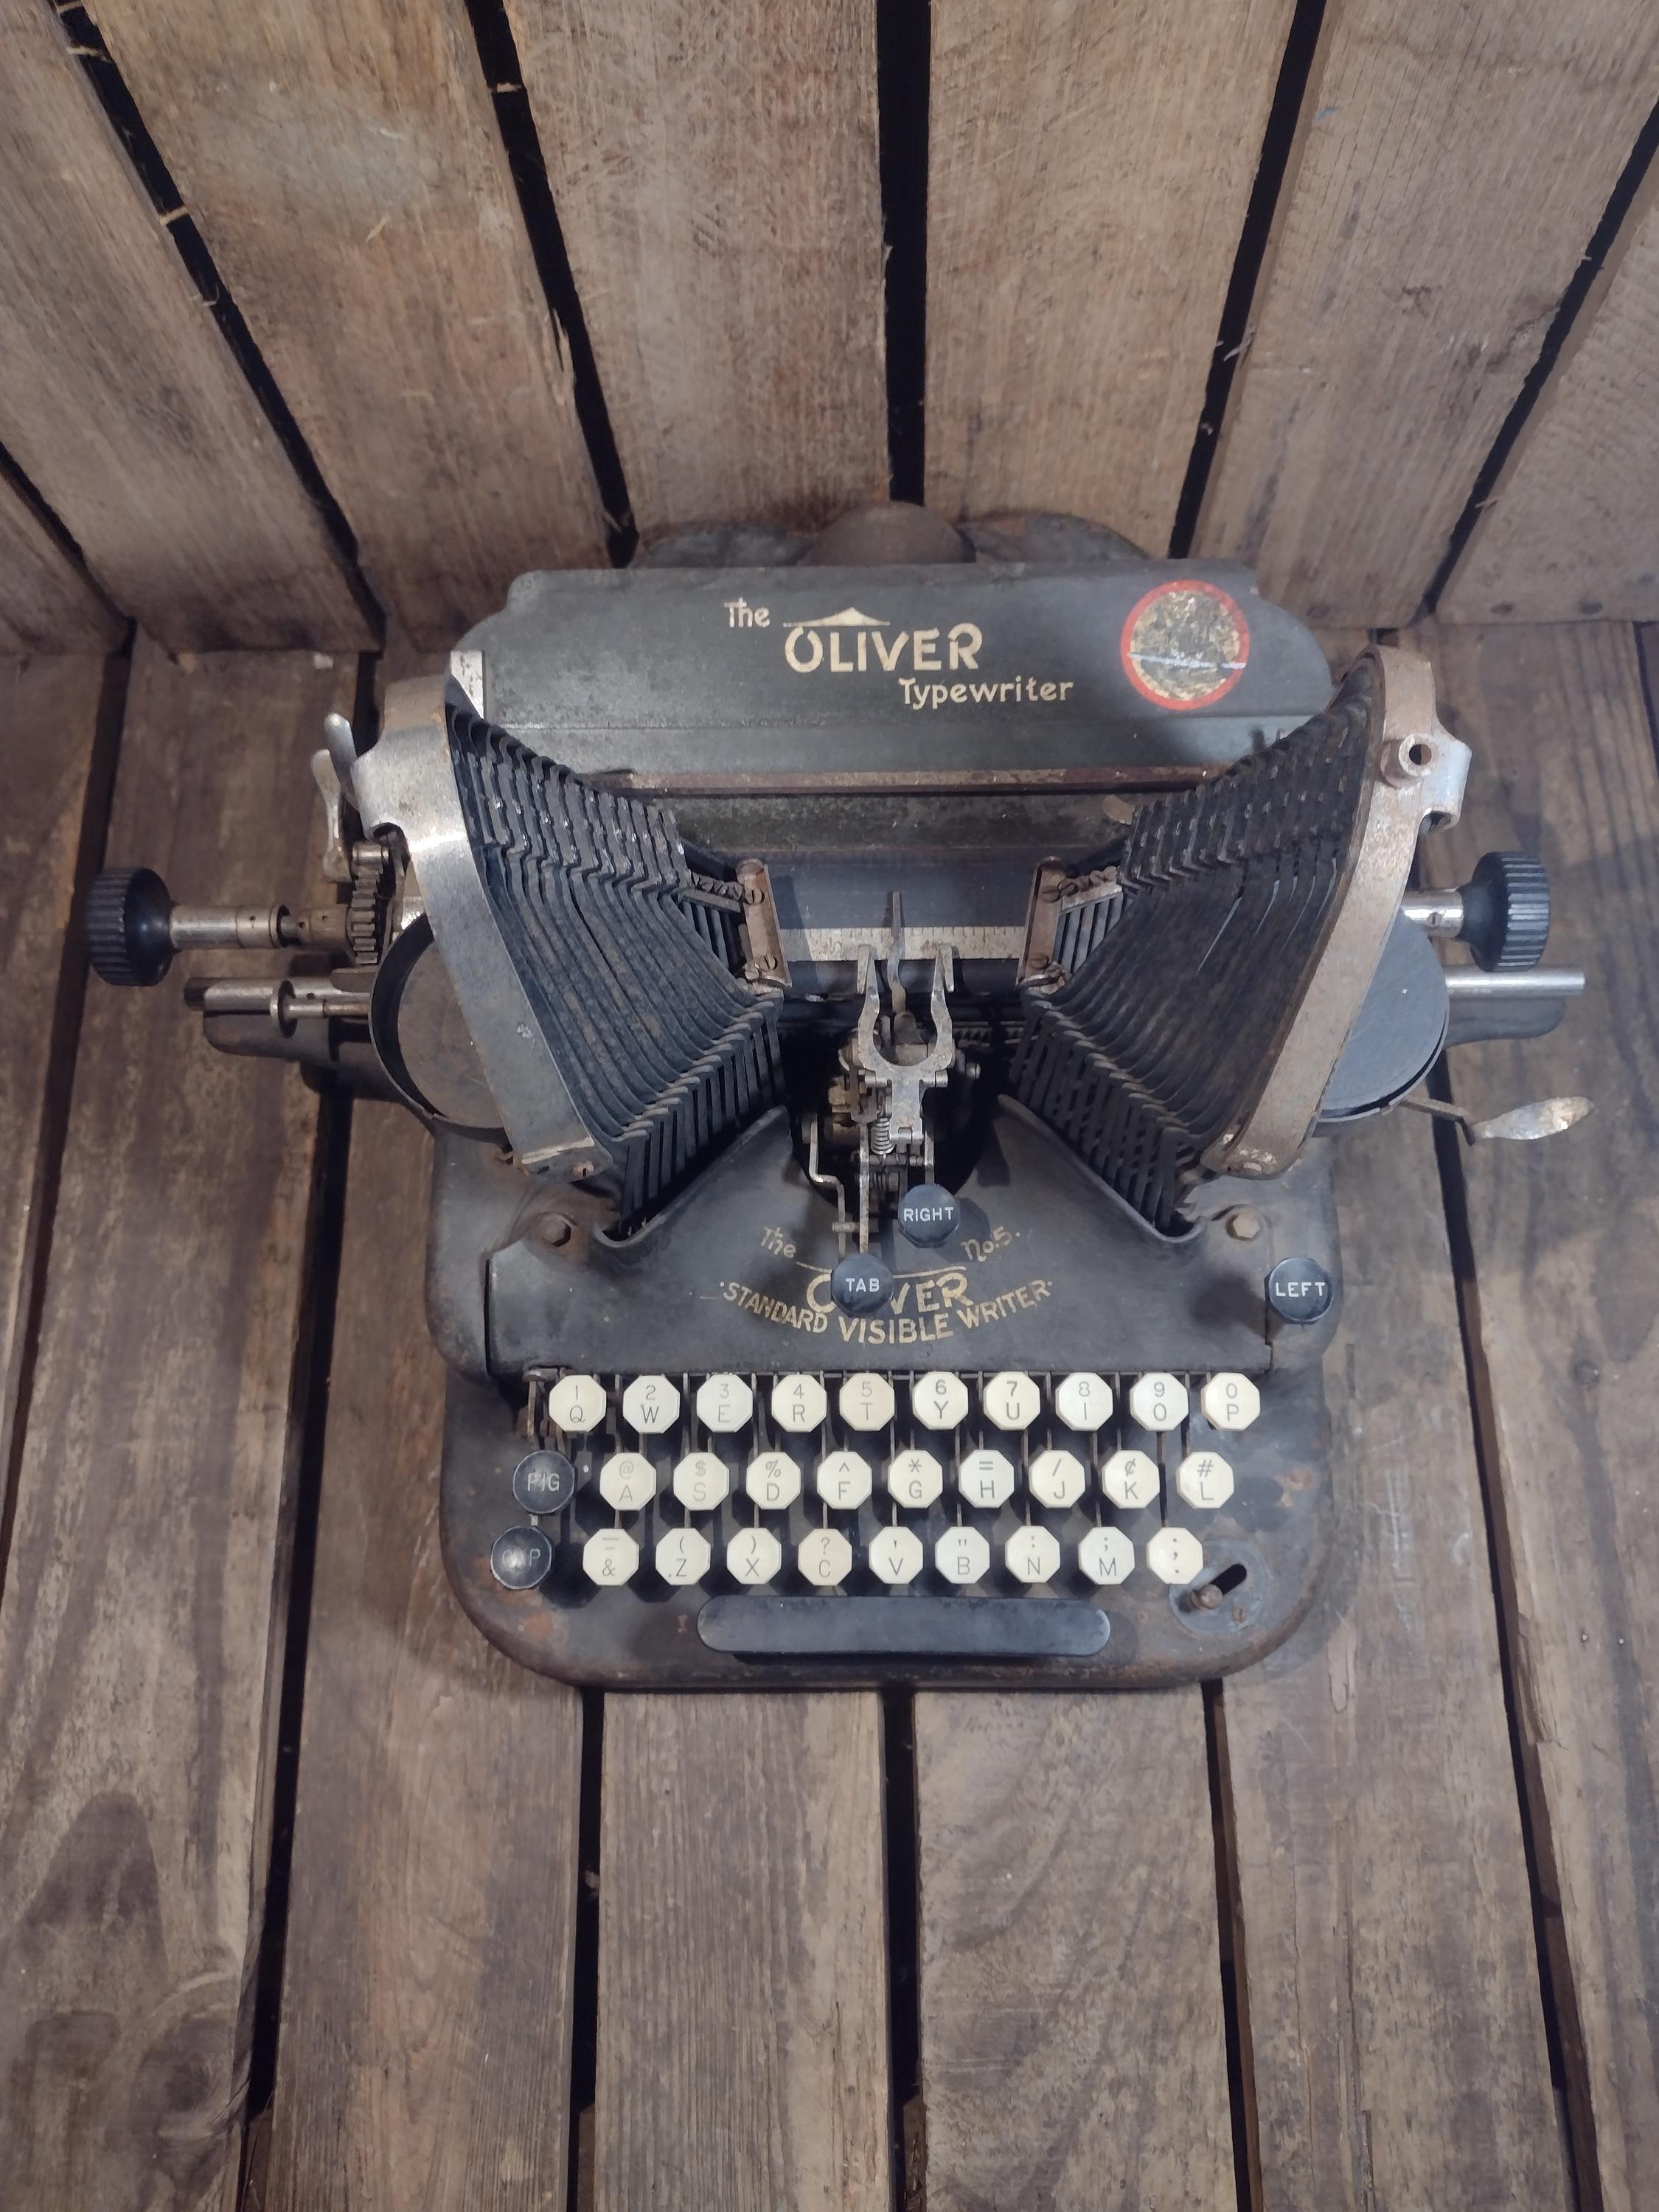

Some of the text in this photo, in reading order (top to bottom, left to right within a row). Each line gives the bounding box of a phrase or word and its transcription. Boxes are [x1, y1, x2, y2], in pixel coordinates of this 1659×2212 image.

[724, 598, 771, 628] The
[785, 623, 983, 672] OLIVER
[898, 676, 1074, 711] Typewriter
[904, 1206, 954, 1222] RIGHT
[759, 1226, 797, 1258] The
[807, 1273, 976, 1315] OVER
[846, 1278, 880, 1293] TAB
[1275, 1281, 1326, 1298] LEFT
[838, 1313, 954, 1344] VISIBLE
[645, 1384, 656, 1401] 2
[720, 1383, 730, 1399] 3
[793, 1382, 805, 1399] 4
[860, 1380, 873, 1397] 5
[935, 1379, 947, 1396] 6
[1006, 1380, 1018, 1398] 7
[1078, 1380, 1091, 1397] 8
[1153, 1381, 1166, 1398] 9
[1225, 1382, 1238, 1399] 0
[569, 1405, 586, 1424] Q
[639, 1403, 660, 1425] W
[717, 1404, 731, 1424] E
[792, 1403, 806, 1423] R
[860, 1402, 874, 1422] T
[933, 1399, 949, 1420] Y
[1005, 1402, 1020, 1421] U
[1152, 1402, 1167, 1422] O
[1226, 1403, 1239, 1422] P
[619, 1461, 635, 1478] @
[695, 1460, 707, 1478] $
[765, 1459, 782, 1479] %
[1124, 1458, 1137, 1478] ¢
[1197, 1459, 1214, 1478] #
[619, 1484, 634, 1502] A
[693, 1481, 706, 1502] S
[766, 1482, 780, 1502] D
[838, 1481, 851, 1500] F
[908, 1479, 922, 1500] G
[979, 1479, 995, 1499] H
[1053, 1480, 1065, 1500] J
[1124, 1481, 1139, 1500] K
[1200, 1481, 1215, 1501] L
[821, 1537, 830, 1556] ?
[602, 1558, 616, 1577] &
[745, 1557, 760, 1577] X
[818, 1559, 831, 1579] C
[888, 1557, 905, 1576] V
[957, 1556, 971, 1576] B
[1027, 1557, 1040, 1576] N
[1099, 1557, 1117, 1577] M
